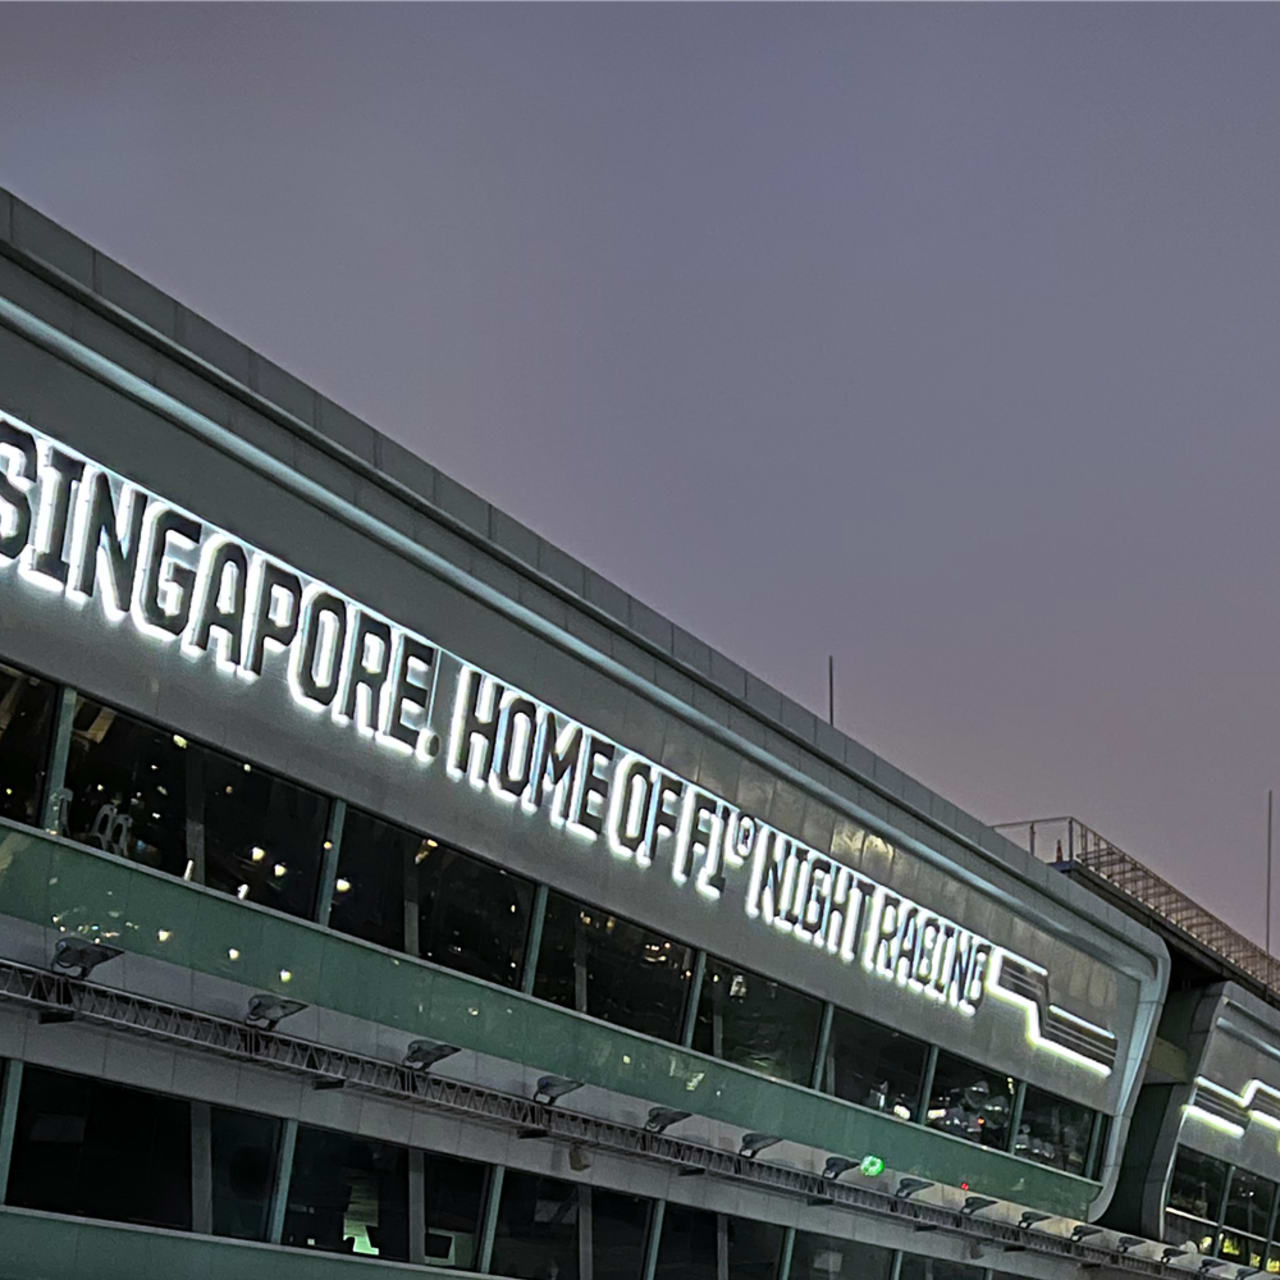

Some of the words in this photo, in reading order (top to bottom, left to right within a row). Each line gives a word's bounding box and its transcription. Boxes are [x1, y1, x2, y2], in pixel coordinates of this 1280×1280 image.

[446, 664, 615, 842] HOME
[609, 753, 684, 869] OF
[744, 824, 877, 962] NIGHT
[860, 885, 993, 1016] RACING
